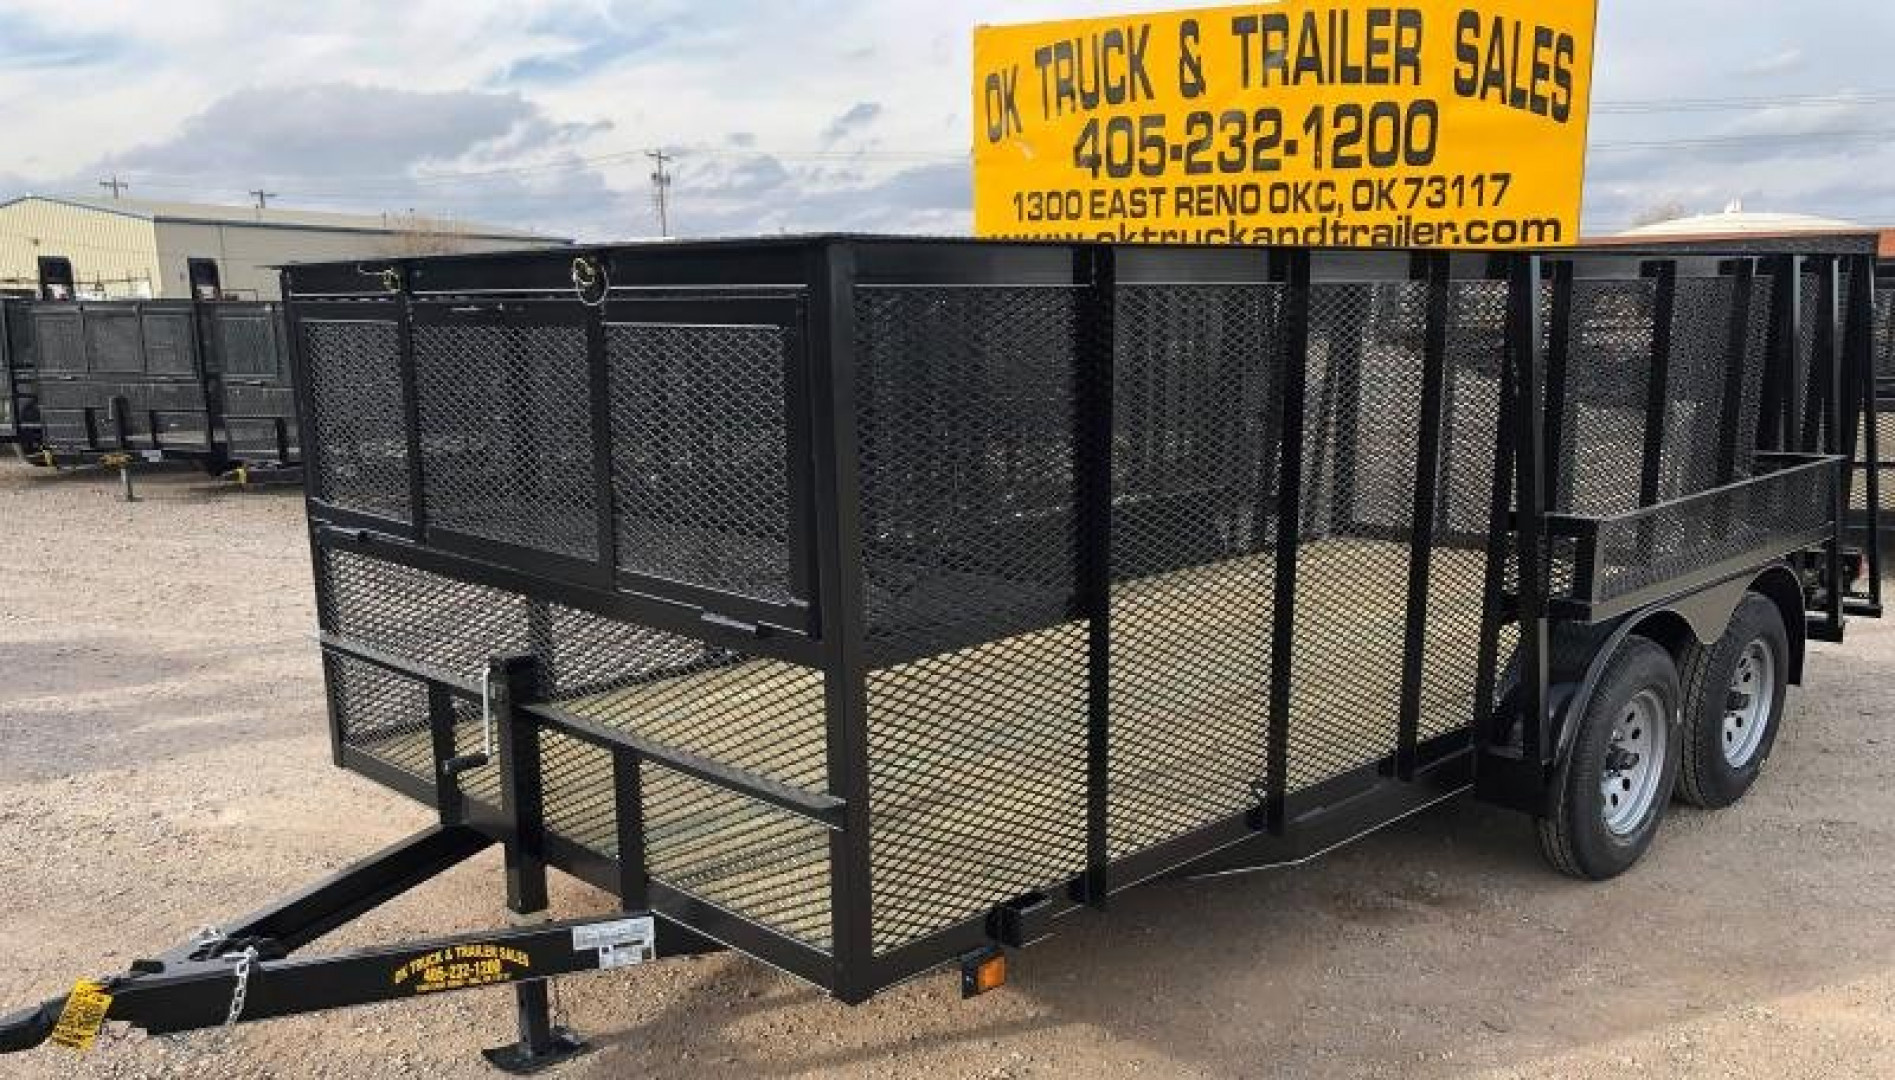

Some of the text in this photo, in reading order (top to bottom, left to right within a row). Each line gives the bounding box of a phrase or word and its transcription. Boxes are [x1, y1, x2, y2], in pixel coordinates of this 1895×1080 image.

[985, 8, 1574, 144] OK TRUCK & TRAILER SALES
[1074, 99, 1438, 180] 405-232-1200
[991, 214, 1561, 245] ktruckandtrailer.com
[1013, 172, 1511, 222] 1300 EAST RENO OKC, OK 73117
